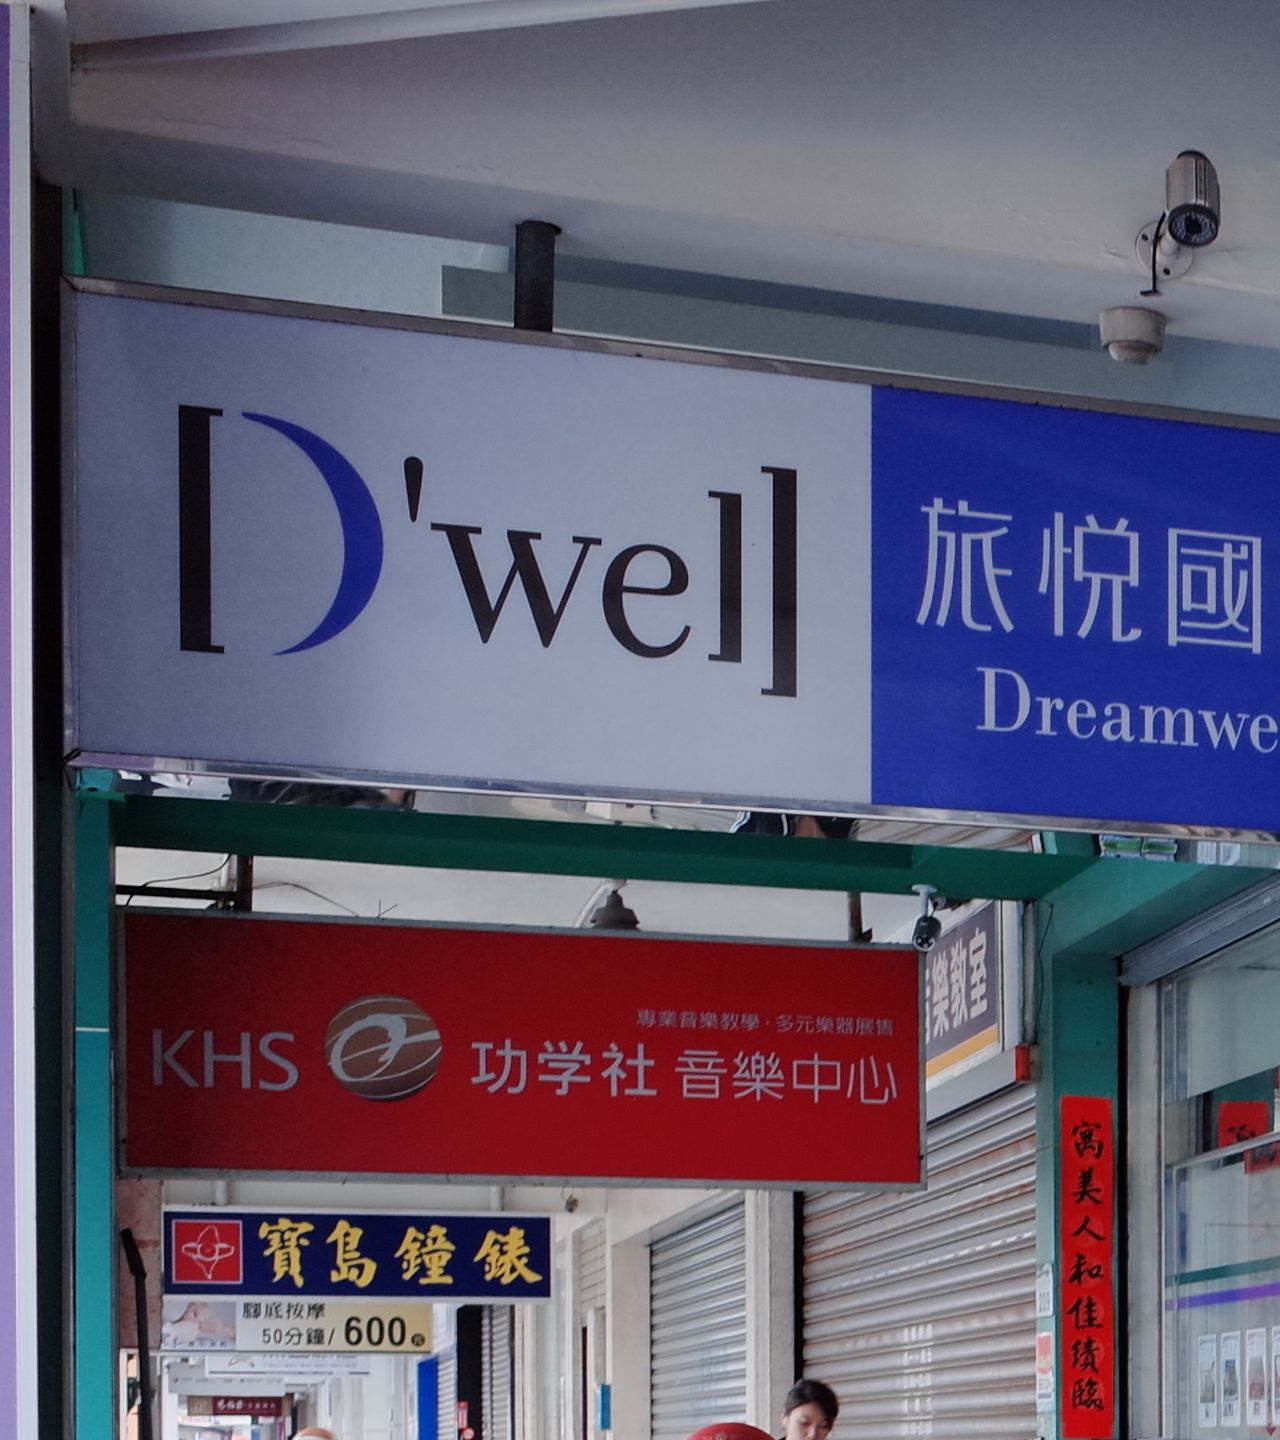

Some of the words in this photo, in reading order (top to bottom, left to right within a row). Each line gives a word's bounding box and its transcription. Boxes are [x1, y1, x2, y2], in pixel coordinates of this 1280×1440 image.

[178, 404, 798, 698] D'well
[925, 927, 988, 1046] 樂教室
[152, 1028, 299, 1092] KHS
[471, 1038, 658, 1097] 功学社
[674, 1048, 898, 1105] 音樂中心
[257, 1216, 544, 1289] 寶島鐘錶
[344, 1316, 407, 1347] 600
